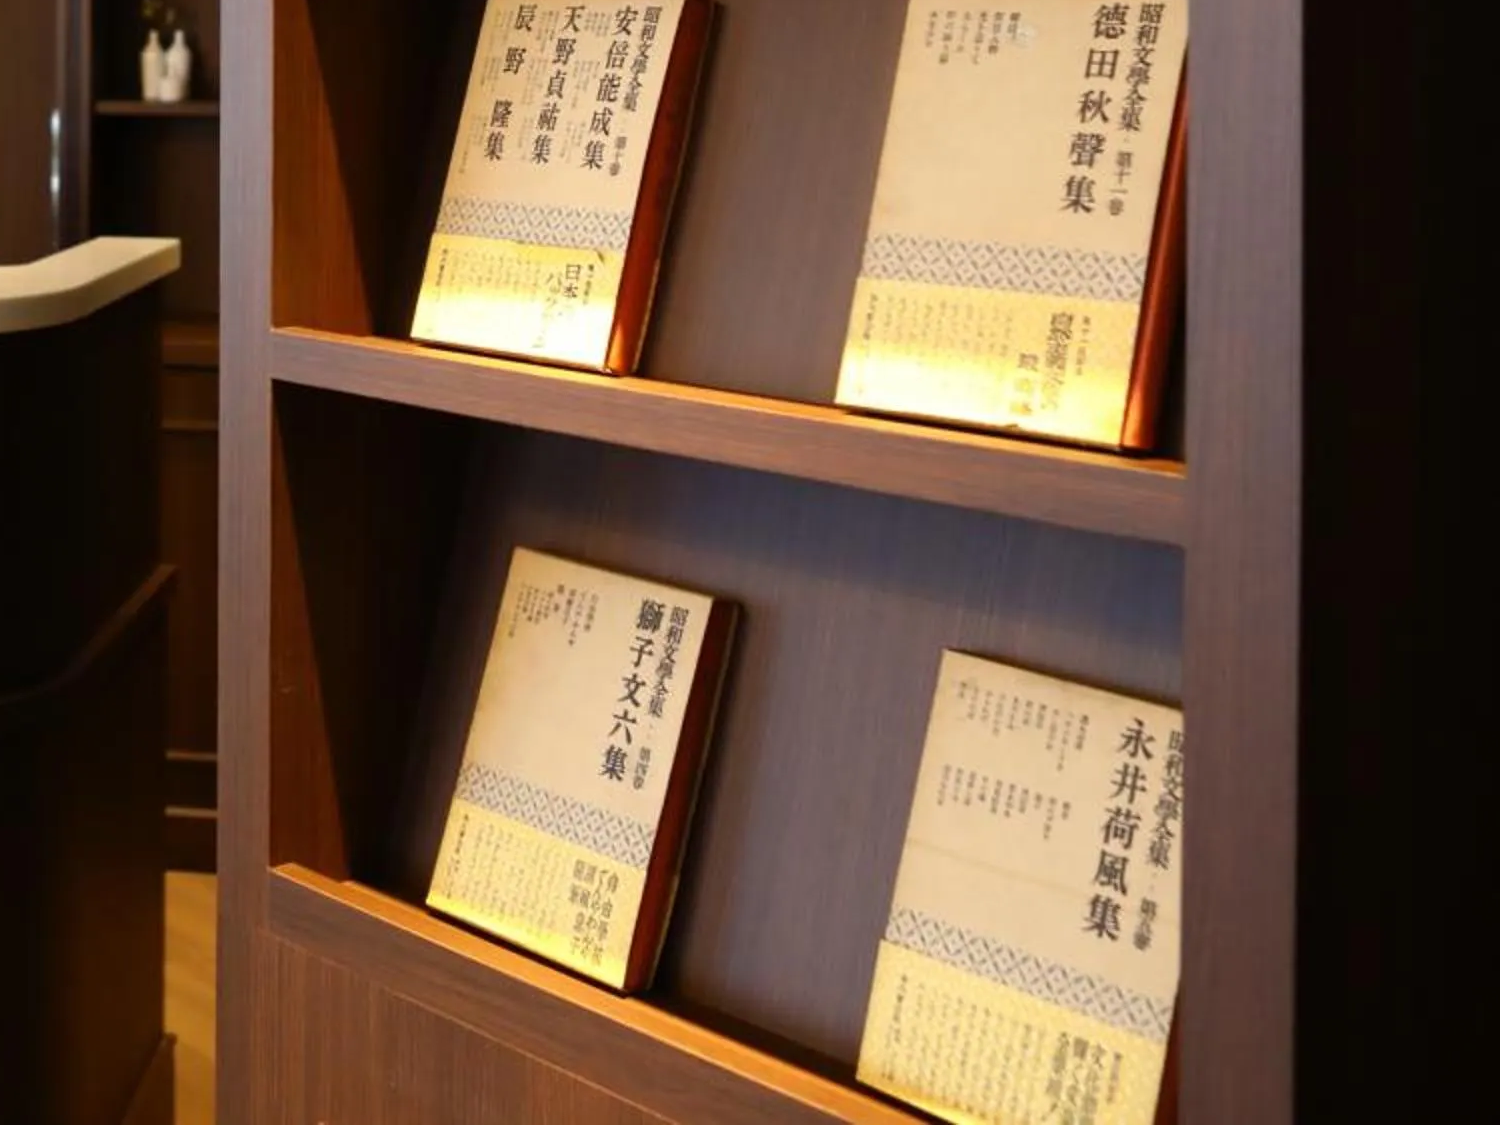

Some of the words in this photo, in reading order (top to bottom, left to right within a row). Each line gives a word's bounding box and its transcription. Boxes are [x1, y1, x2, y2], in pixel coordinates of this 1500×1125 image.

[579, 4, 640, 171] 安倍能成集
[599, 598, 667, 783] 獅子文六集
[1081, 717, 1158, 942] 永井荷風集
